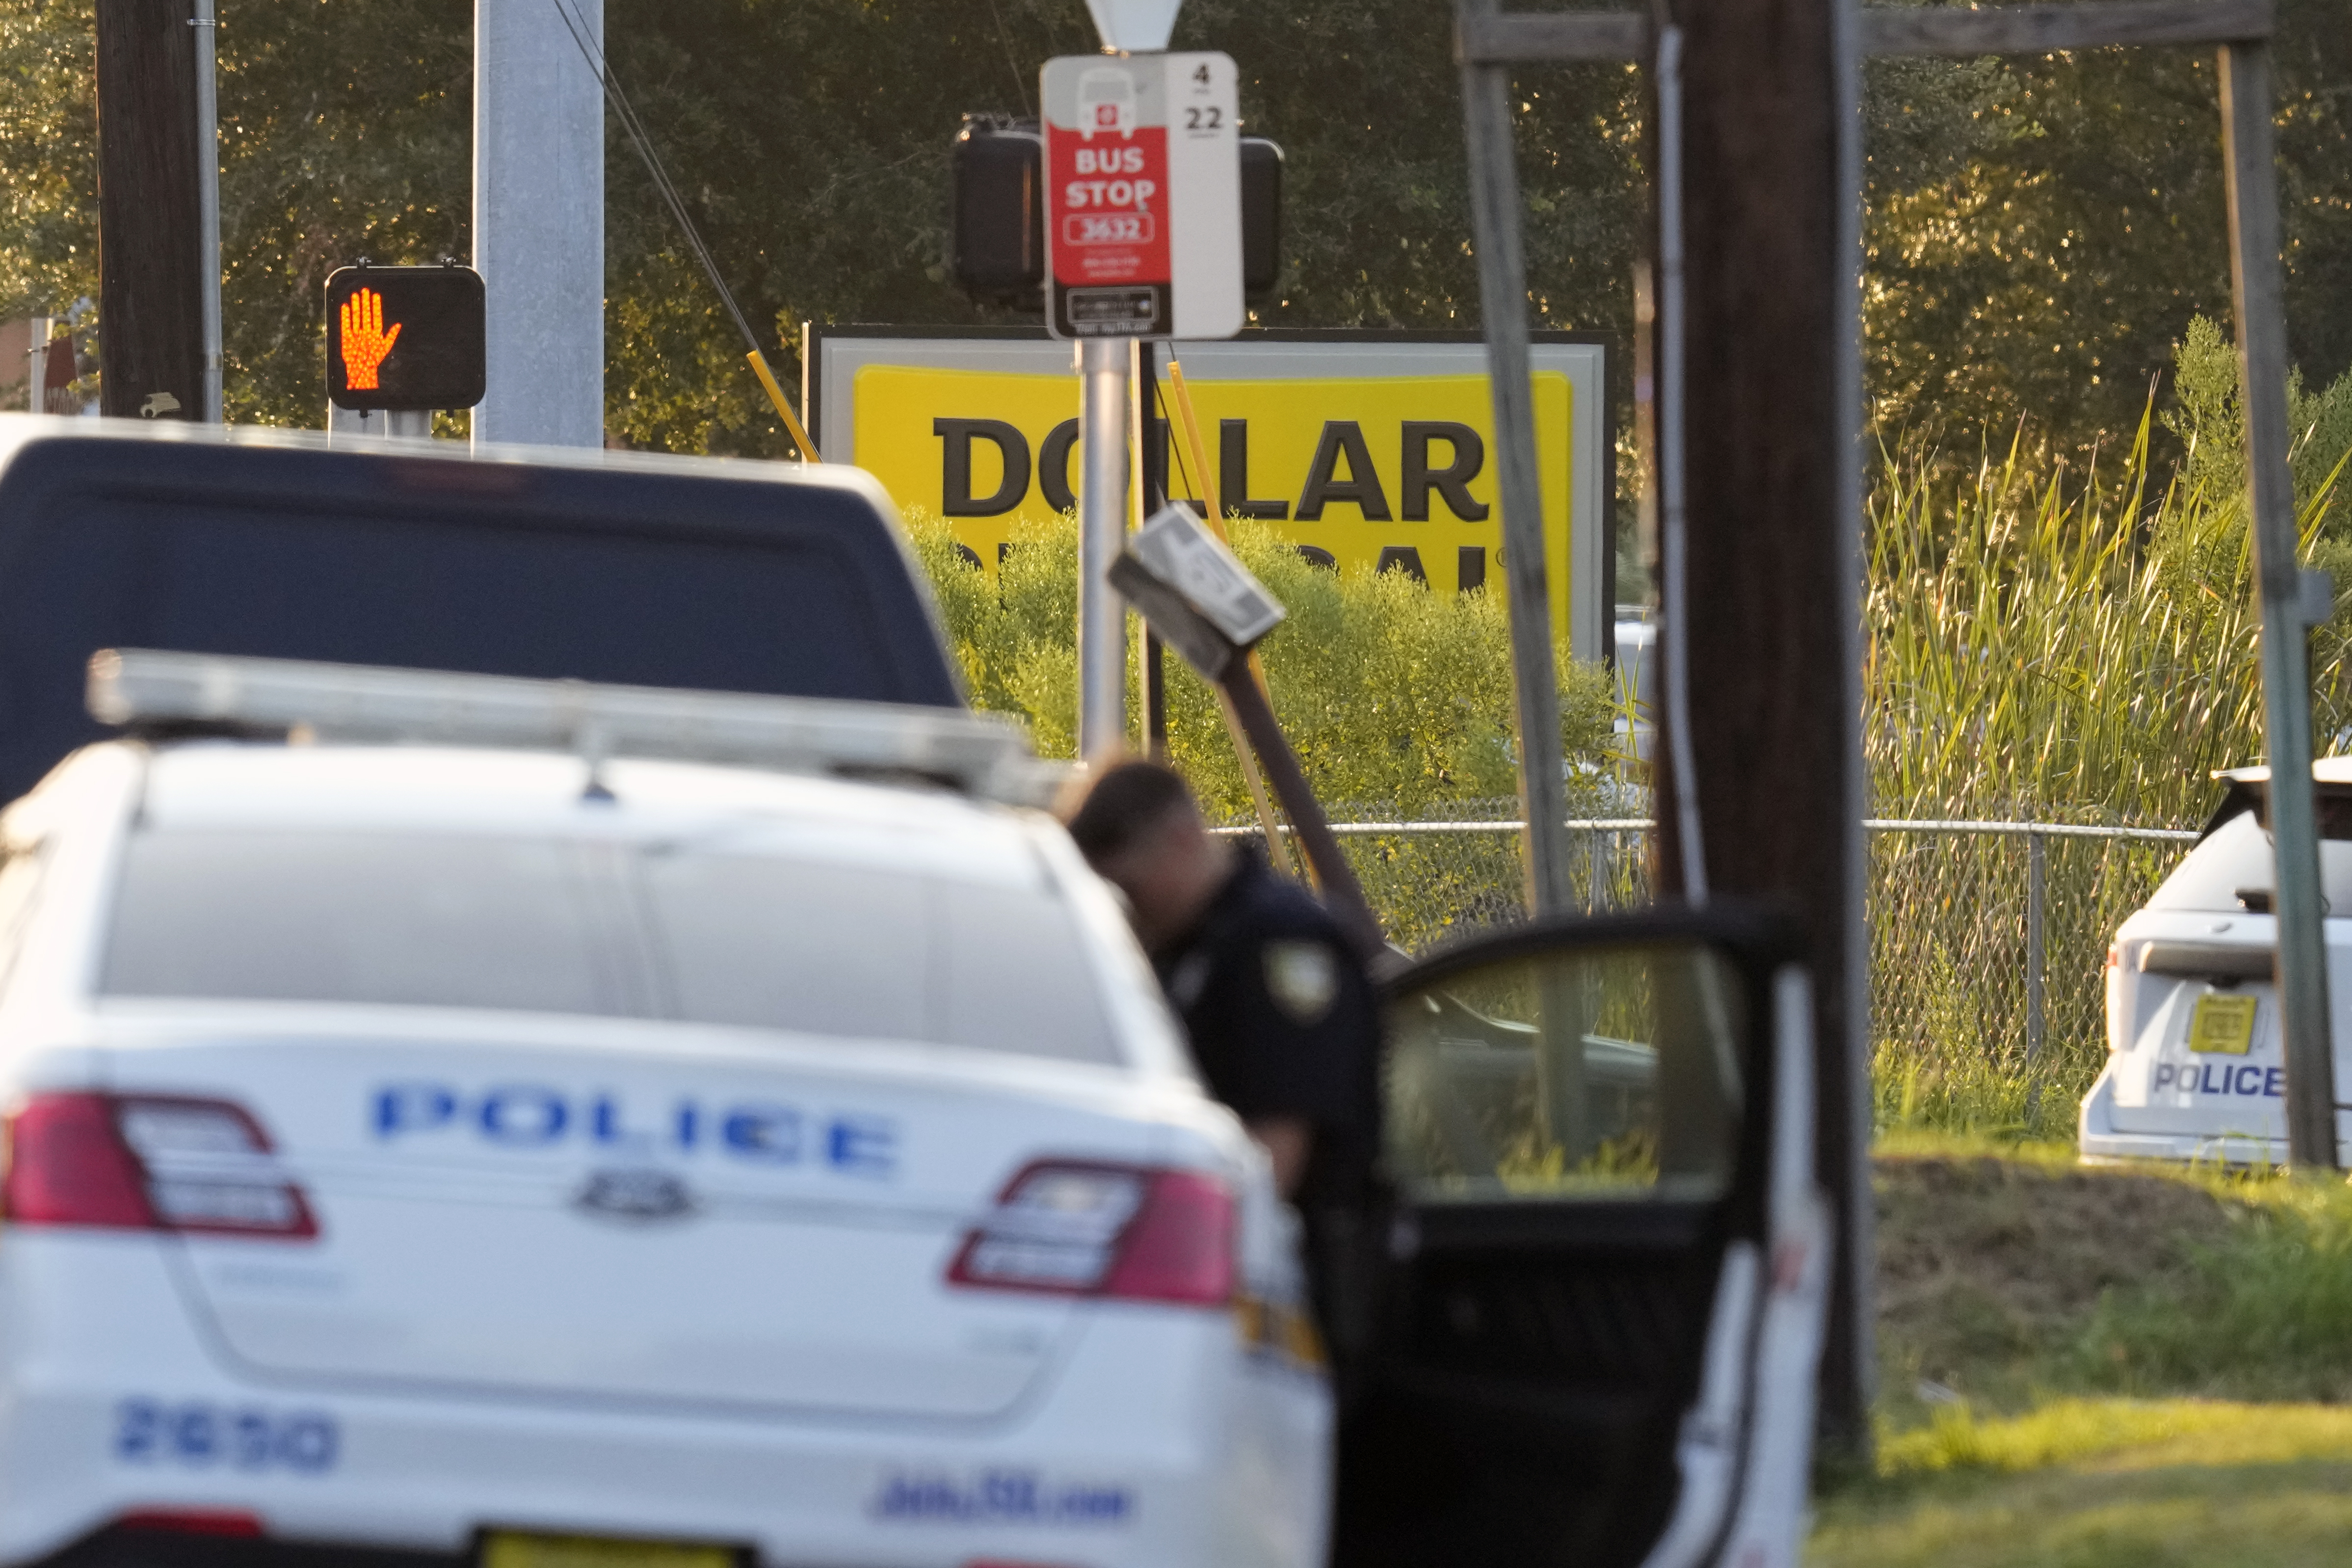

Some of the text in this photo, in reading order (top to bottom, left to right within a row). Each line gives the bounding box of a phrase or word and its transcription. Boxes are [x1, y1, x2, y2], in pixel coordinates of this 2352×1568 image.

[1192, 62, 1211, 85] 4
[1185, 105, 1223, 130] 22
[1075, 147, 1144, 174] BUS
[1066, 180, 1156, 209] STOP
[2154, 1064, 2287, 1097] POLICE
[371, 1080, 899, 1179] POLICE
